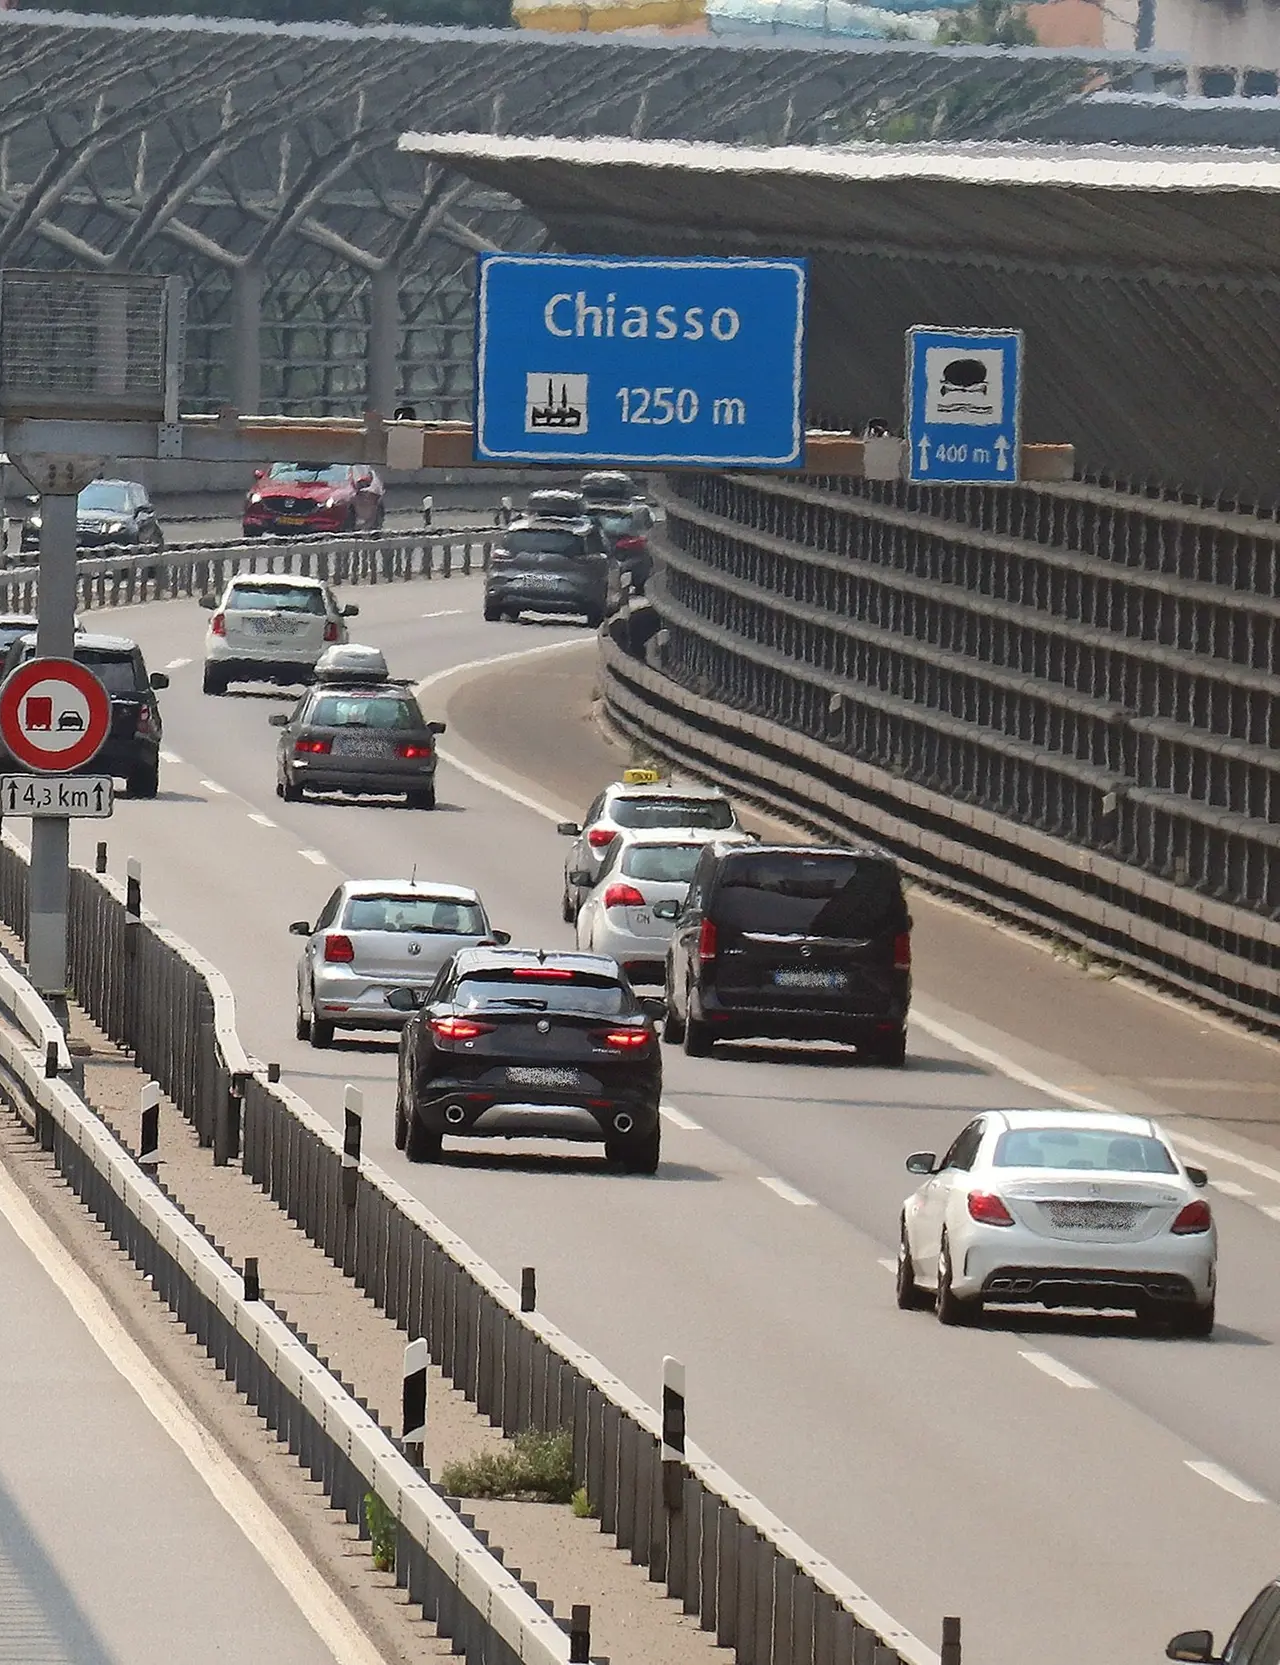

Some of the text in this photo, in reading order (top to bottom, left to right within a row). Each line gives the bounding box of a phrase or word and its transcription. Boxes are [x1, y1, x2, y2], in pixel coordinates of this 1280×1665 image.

[544, 291, 740, 341] Chiasso
[615, 387, 746, 425] 1250 m
[935, 443, 990, 463] 400 m
[23, 783, 88, 808] 4,3 km
